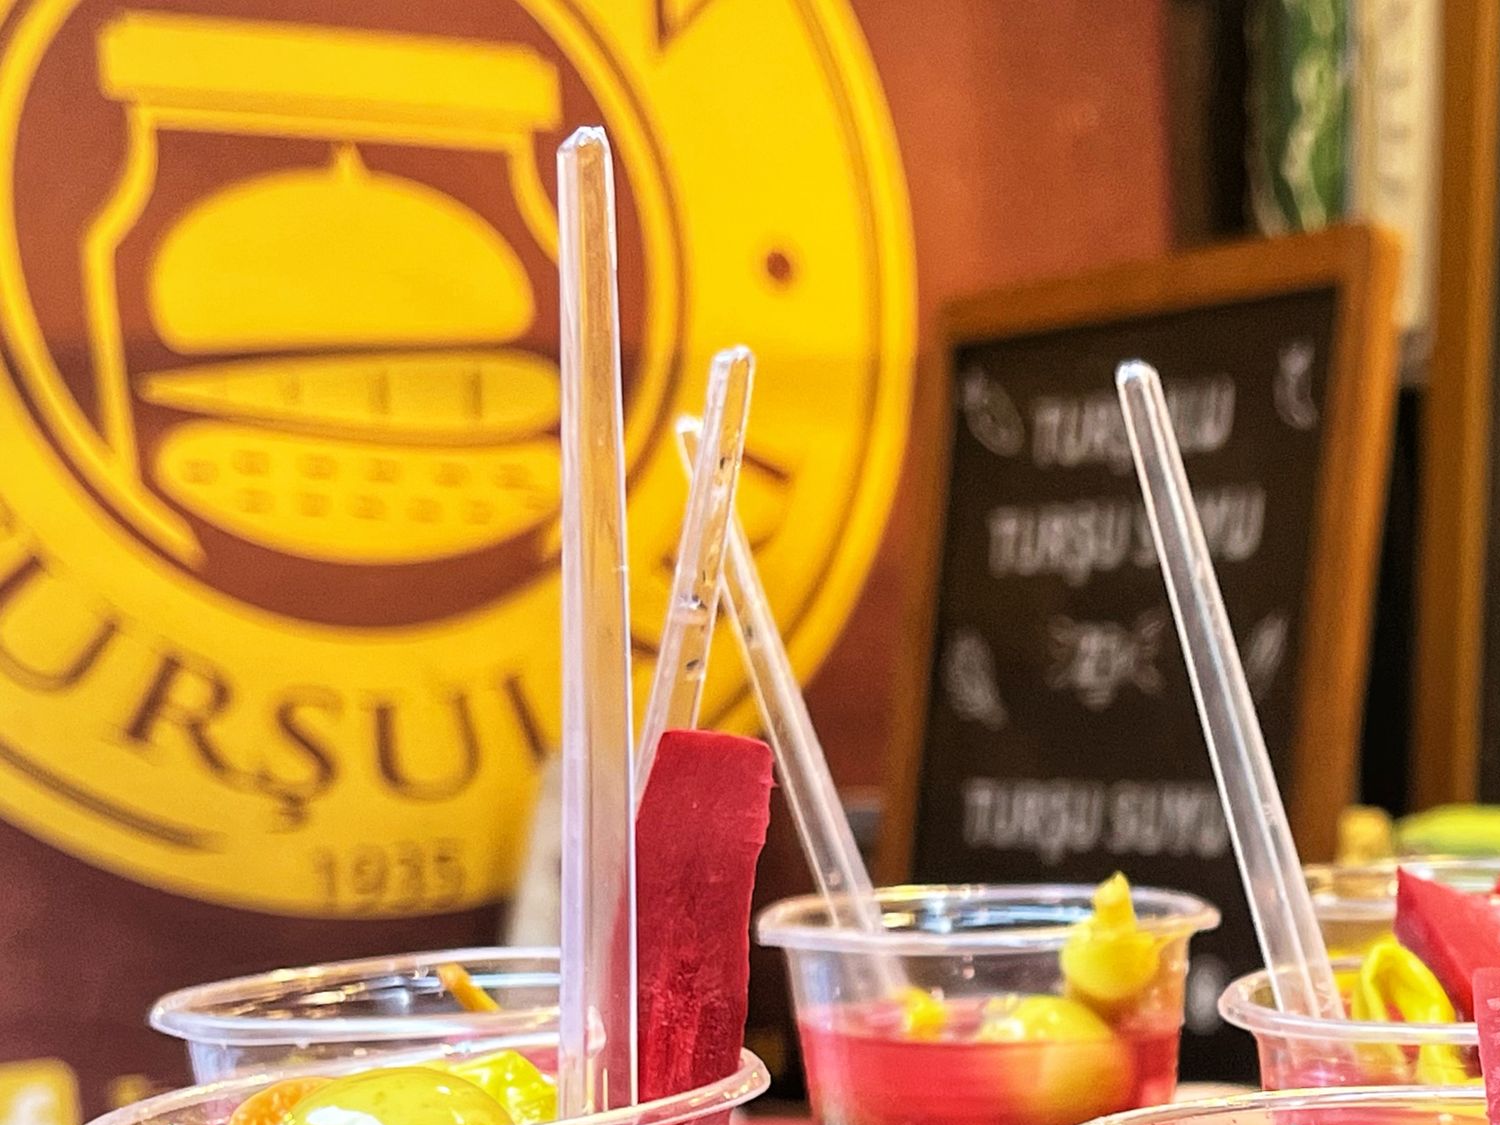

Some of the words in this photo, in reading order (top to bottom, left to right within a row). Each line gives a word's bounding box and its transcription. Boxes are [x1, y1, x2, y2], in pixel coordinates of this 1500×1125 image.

[988, 500, 1131, 586] TURŞU
[963, 778, 1104, 864] TURŞU
[1108, 779, 1230, 858] SUYU
